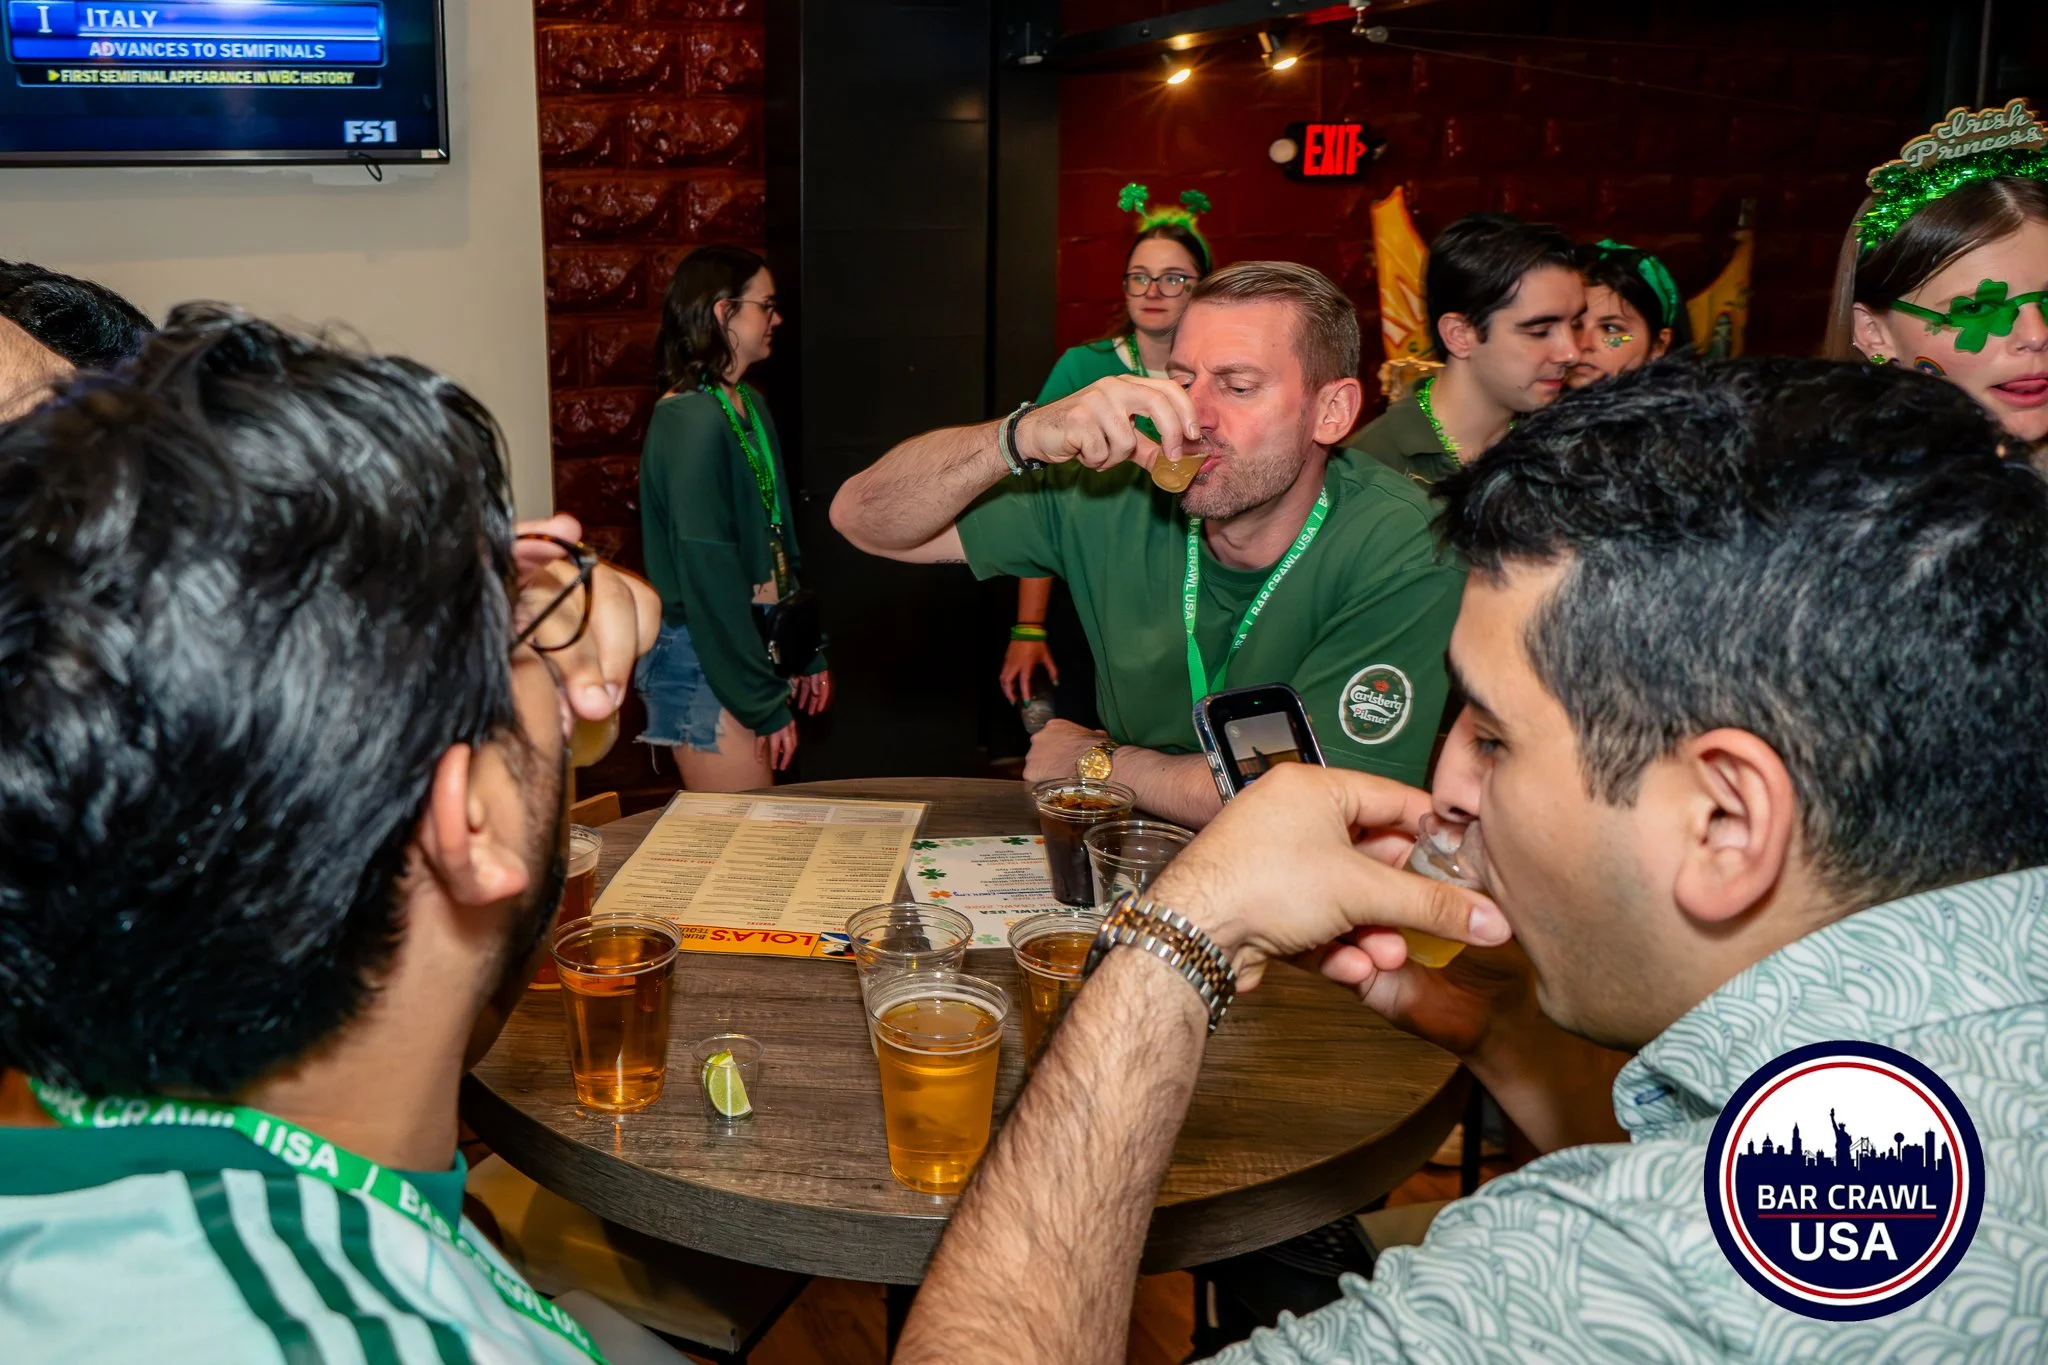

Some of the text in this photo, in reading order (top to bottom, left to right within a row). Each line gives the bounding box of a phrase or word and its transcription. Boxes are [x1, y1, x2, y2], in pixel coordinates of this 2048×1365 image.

[87, 9, 158, 29] ITALY
[89, 42, 326, 59] ADVANCES TO SEMIFINALS
[60, 70, 355, 84] FIRST SEMIFINAL APPEARANCE IN WBC HISTORY
[344, 120, 397, 143] FS1
[1937, 103, 2031, 139] Irish
[1303, 124, 1361, 176] EXIT
[1902, 126, 2043, 168] Princess
[1188, 518, 1201, 544] BAR
[1186, 547, 1199, 591] CRAWL
[1267, 551, 1301, 591] CRAWL
[1295, 526, 1317, 551] USA
[1185, 594, 1194, 620] USA
[1350, 684, 1404, 715] Carlsberg
[1353, 707, 1391, 724] Pilsner
[680, 927, 708, 935] TEQU
[710, 929, 813, 946] LOLA'S
